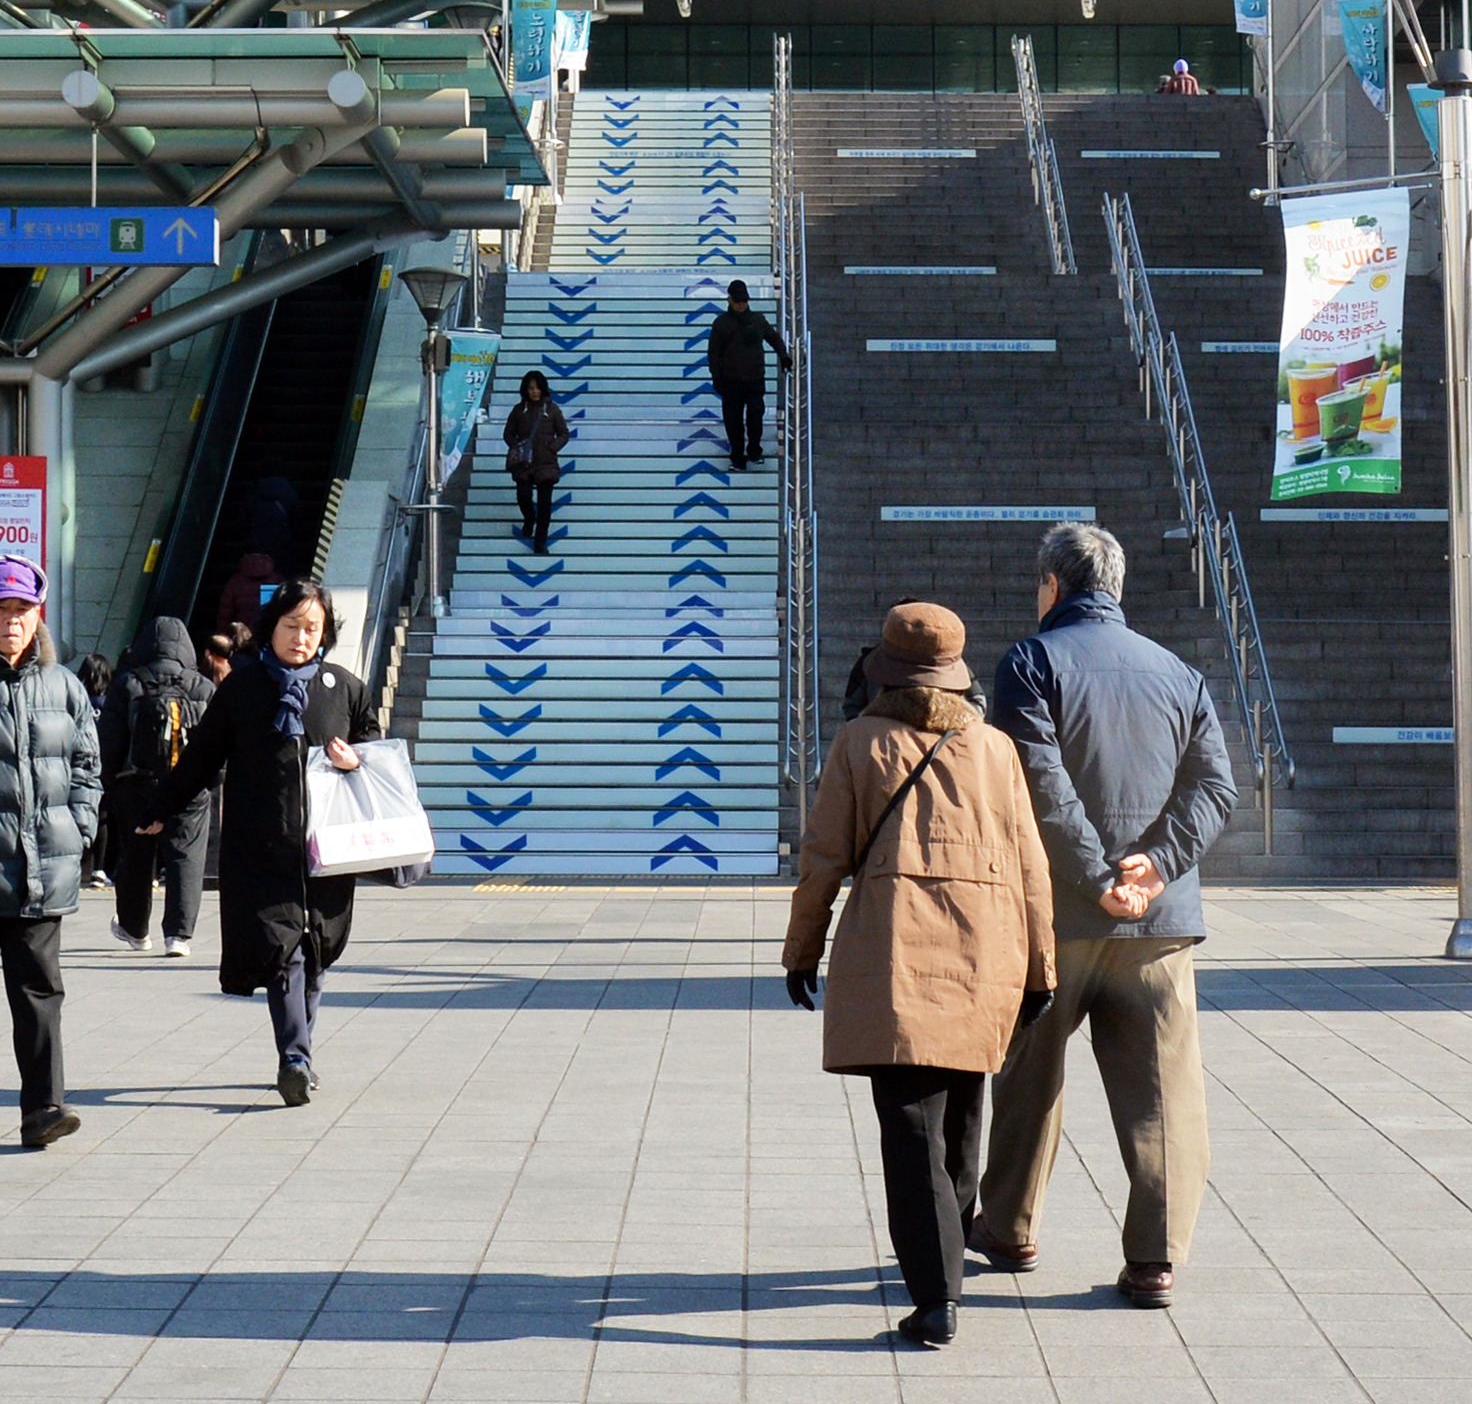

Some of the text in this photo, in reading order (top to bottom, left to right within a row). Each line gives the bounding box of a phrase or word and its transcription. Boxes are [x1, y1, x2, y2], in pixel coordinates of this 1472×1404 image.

[1342, 246, 1398, 269] JUICE
[1299, 327, 1335, 343] 100%
[1336, 319, 1388, 342] 착즙주스
[1397, 730, 1455, 741] 건강이 배움보
